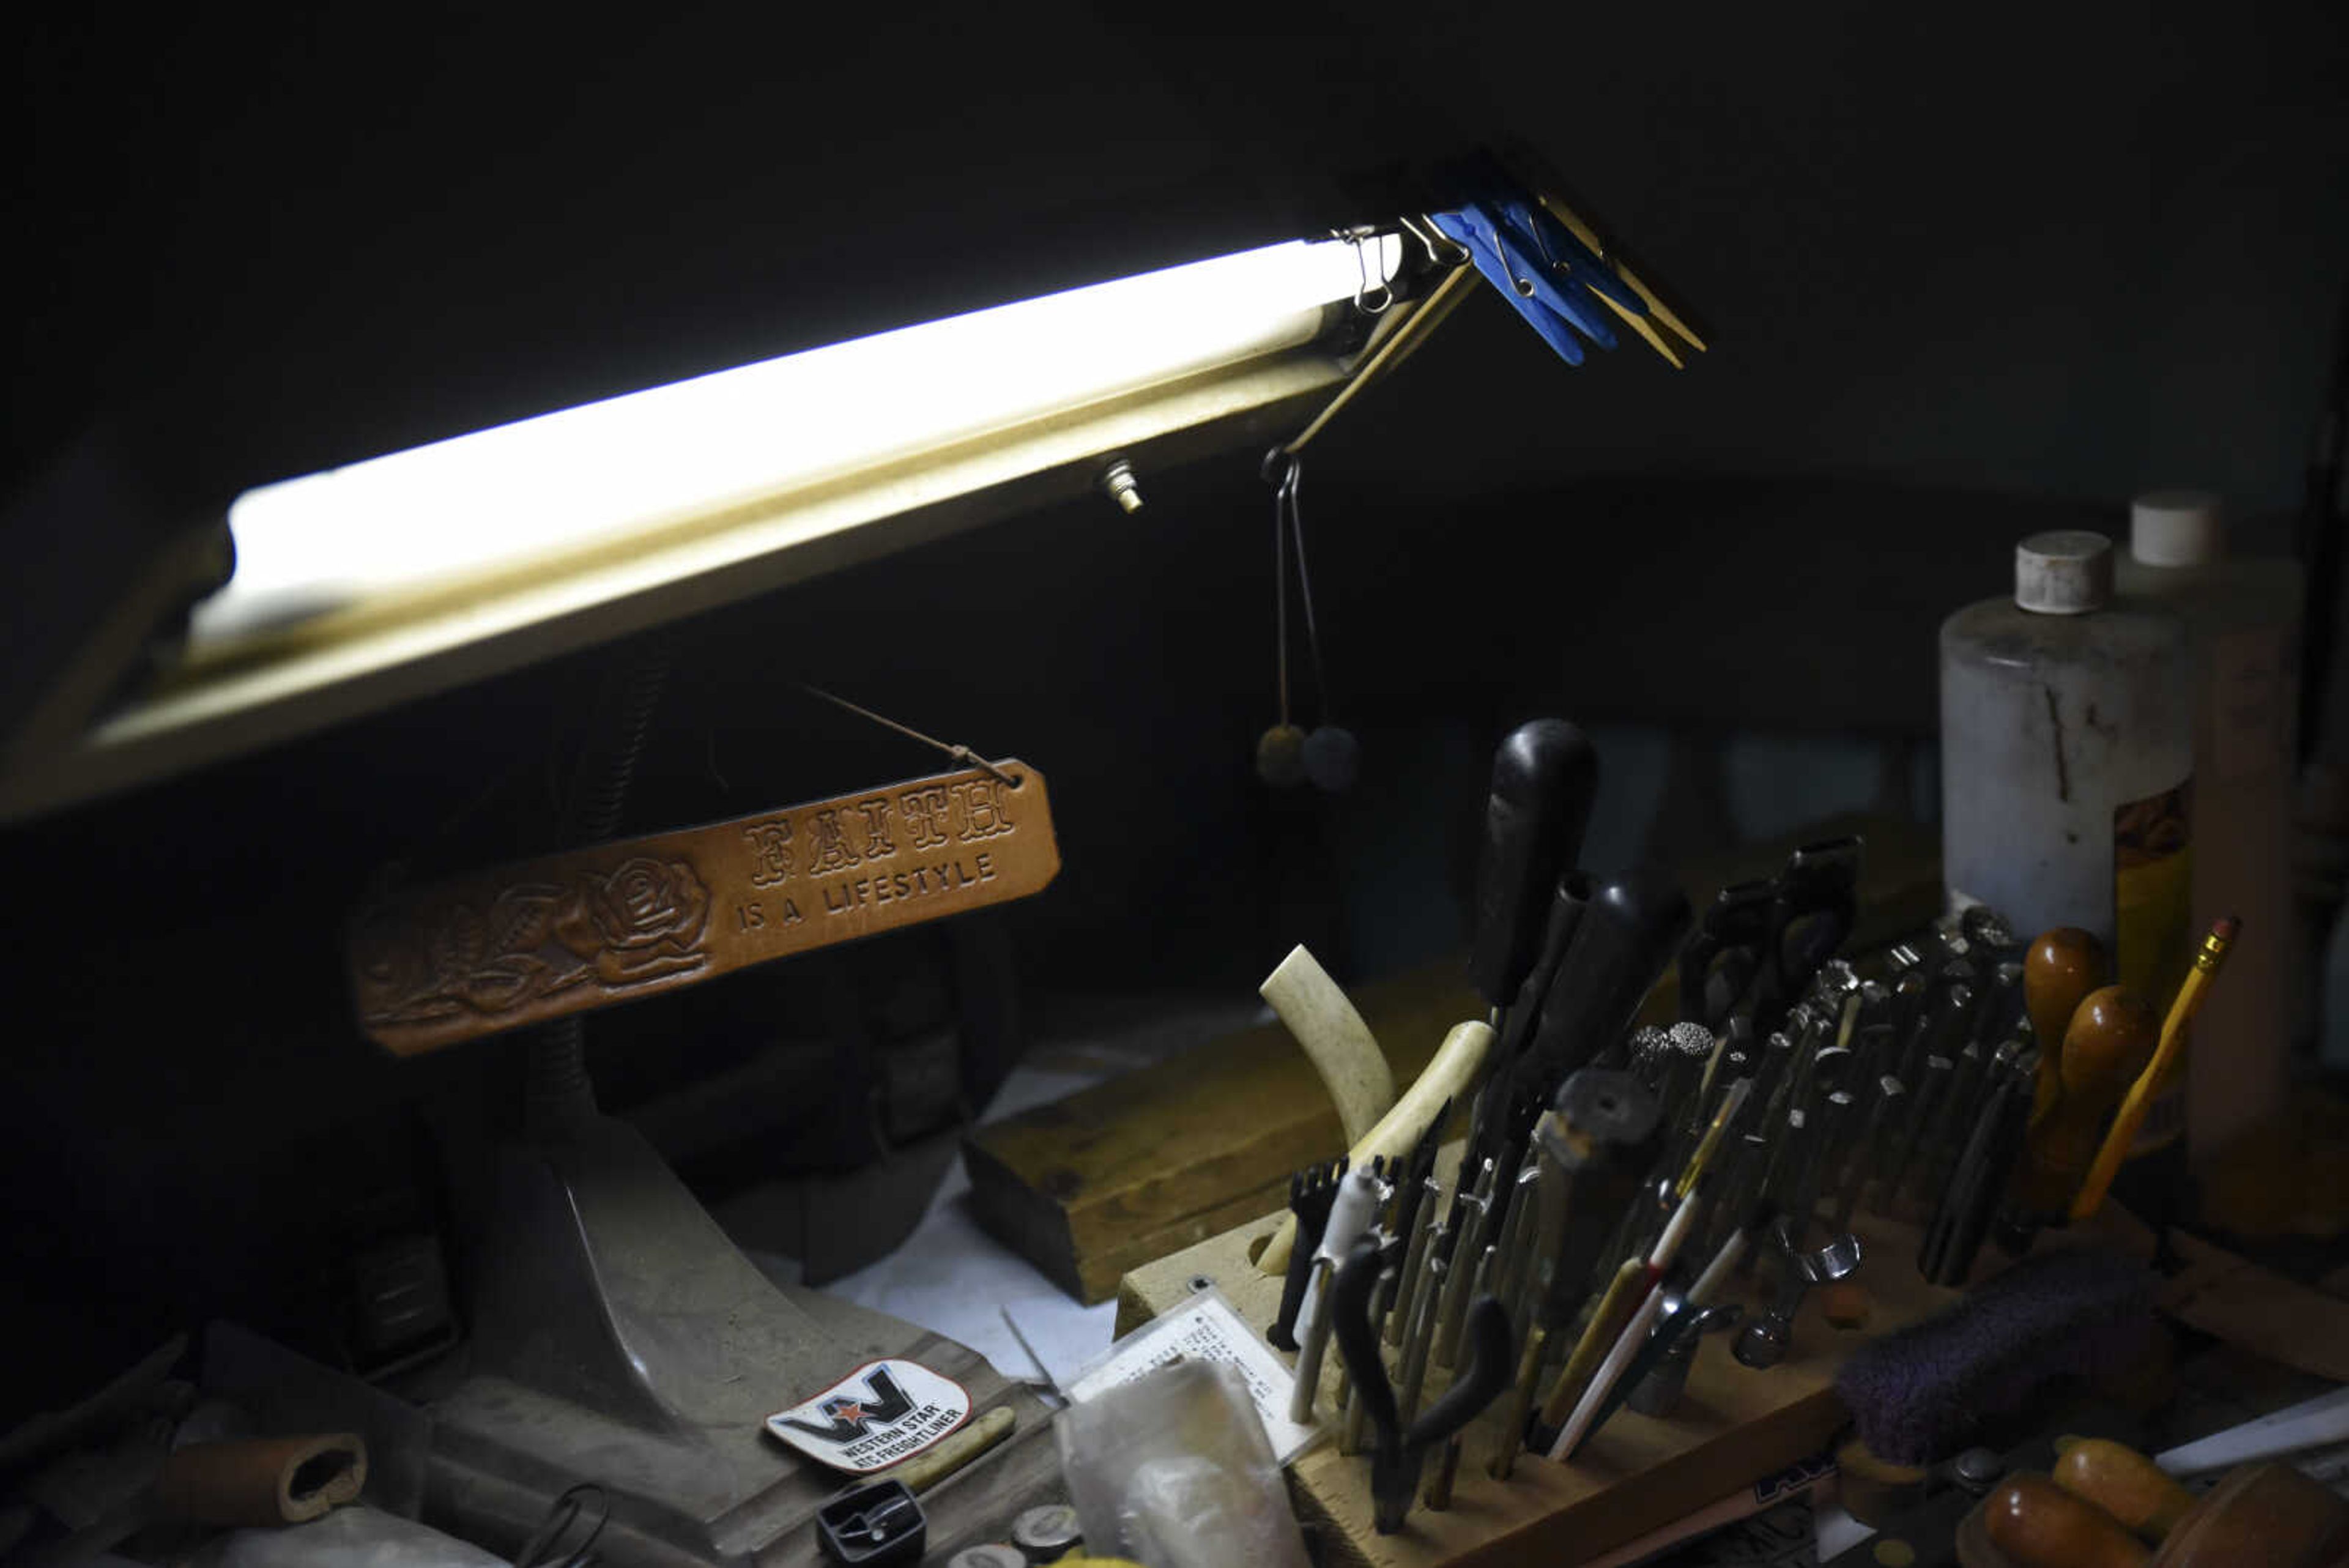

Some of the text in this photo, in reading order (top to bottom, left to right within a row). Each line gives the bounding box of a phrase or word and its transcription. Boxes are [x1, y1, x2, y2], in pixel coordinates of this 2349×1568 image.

[741, 779, 1017, 887] FAITH
[736, 852, 998, 932] IS A LIFESTYLE
[842, 1404, 941, 1458] WESTERN STAR
[877, 1409, 964, 1462] FREIGHTLINER
